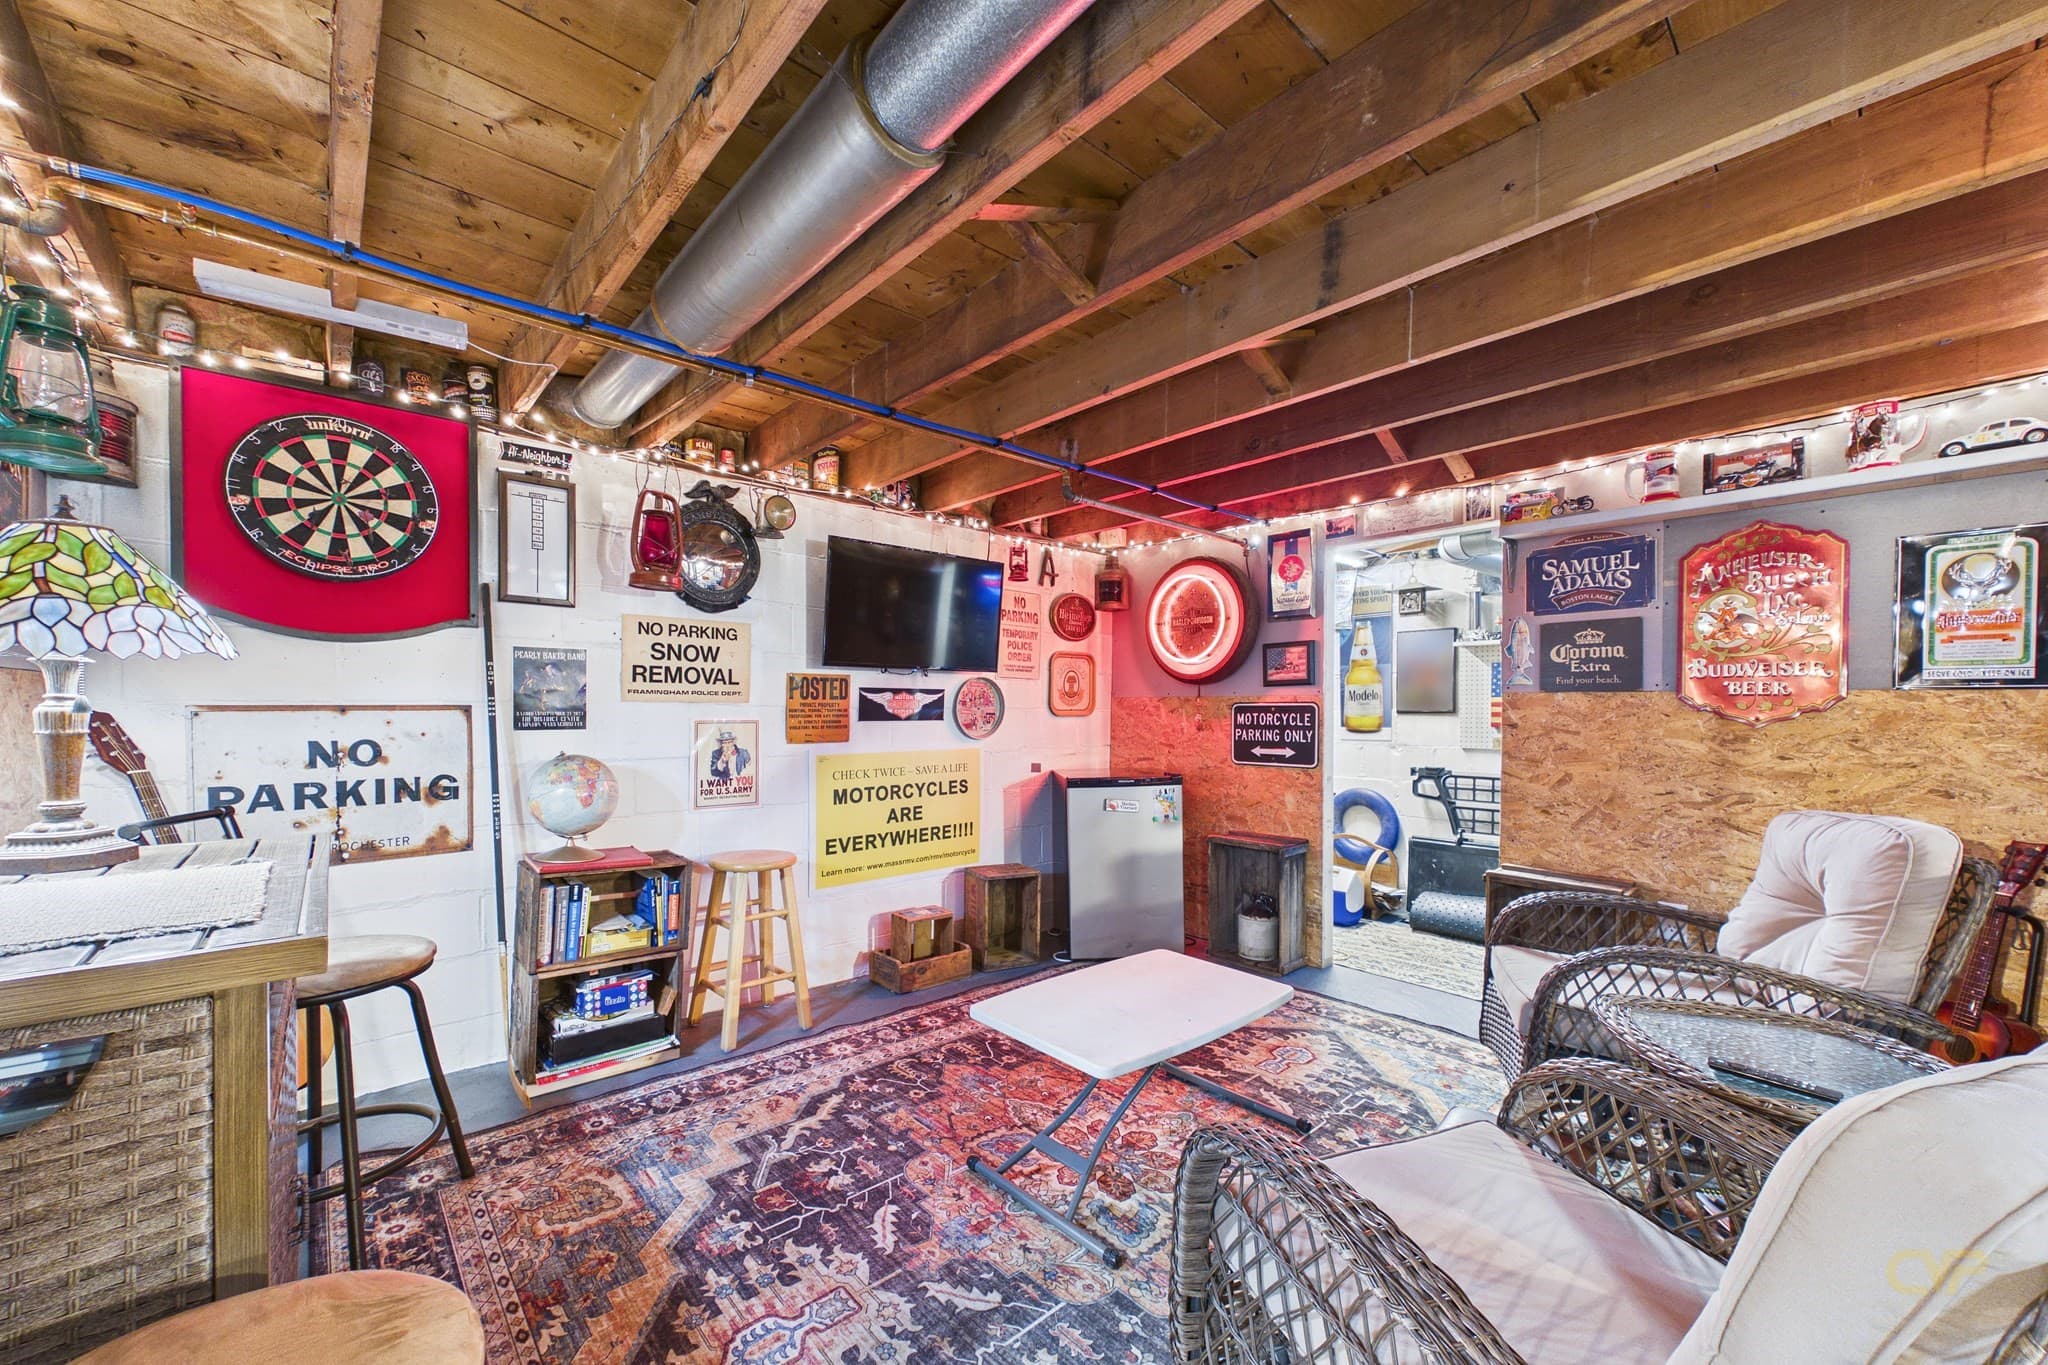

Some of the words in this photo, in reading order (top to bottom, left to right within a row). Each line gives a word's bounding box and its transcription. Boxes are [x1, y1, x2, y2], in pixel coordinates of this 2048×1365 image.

[306, 418, 372, 441] unicorn
[284, 549, 354, 574] ECLIPSE
[358, 561, 389, 574] PRO
[1542, 550, 1640, 581] SAMUEL
[1548, 569, 1632, 598] ADAMS
[1689, 550, 1825, 599] ANHEUSER
[1745, 568, 1833, 594] BUSCH
[1013, 595, 1027, 609] NO
[1560, 593, 1589, 607] BOSTON
[1001, 608, 1039, 625] PARKING
[638, 621, 663, 636] NO
[668, 623, 738, 641] PARKING
[1002, 628, 1039, 641] TEMPORARY
[650, 642, 720, 663] SNOW
[1007, 640, 1033, 652] POLICE
[1550, 643, 1629, 665] Corona
[514, 650, 541, 660] PEARLY
[543, 651, 566, 661] BAKER
[567, 652, 586, 661] BAND
[1007, 651, 1032, 662] ORDER
[632, 664, 740, 685] REMOVAL
[1570, 659, 1610, 673] Extra
[1687, 658, 1834, 680] BUDWEISER
[789, 676, 849, 700] POSTED
[1556, 676, 1574, 685] Find
[1575, 677, 1593, 686] your
[1723, 680, 1793, 697] BEER
[627, 688, 689, 696] FRAMINGHAM
[691, 689, 719, 697] POLICE
[1349, 688, 1379, 702] Modelo
[1237, 713, 1311, 726] MOTORCYCLE
[1235, 729, 1280, 742] PARKING
[1284, 729, 1313, 743] ONLY
[307, 739, 383, 769] NO
[832, 768, 870, 781] CHECK
[873, 766, 905, 778] TWICE
[915, 764, 939, 775] SAVE
[940, 764, 948, 773] A
[949, 762, 969, 774] LIFE
[700, 779, 703, 789] I
[707, 777, 733, 788] WANT
[735, 775, 754, 786] YOU
[700, 788, 714, 796] FOR
[716, 787, 732, 795] U.S.
[732, 785, 753, 794] ARMY
[207, 774, 460, 815] PARKING
[833, 778, 969, 806] MOTORCYCLES
[886, 805, 923, 824] ARE
[331, 836, 410, 851] ROCHESTER
[825, 821, 974, 856] EVERYWHERE!!!!
[821, 868, 843, 878] Learn
[844, 865, 865, 875] more:
